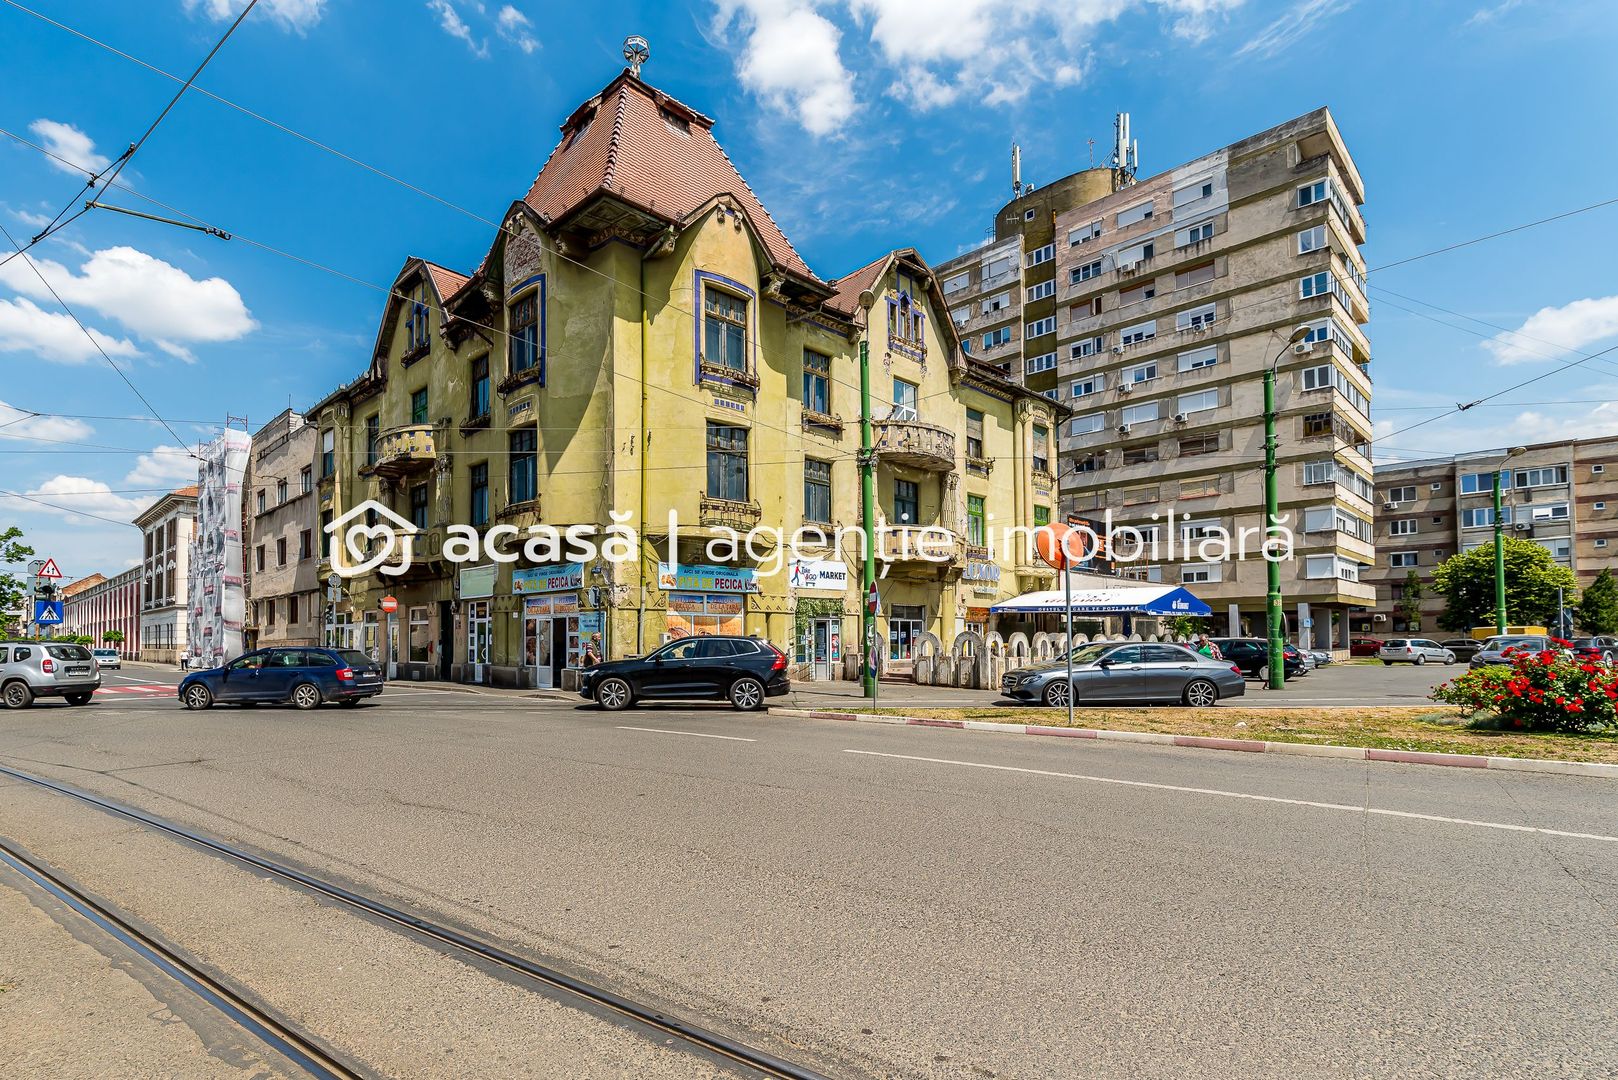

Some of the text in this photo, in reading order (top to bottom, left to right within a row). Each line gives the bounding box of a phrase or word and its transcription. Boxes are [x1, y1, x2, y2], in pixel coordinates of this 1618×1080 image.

[819, 570, 846, 581] MARKET
[547, 576, 569, 589] PECICA
[714, 577, 743, 590] PECICA
